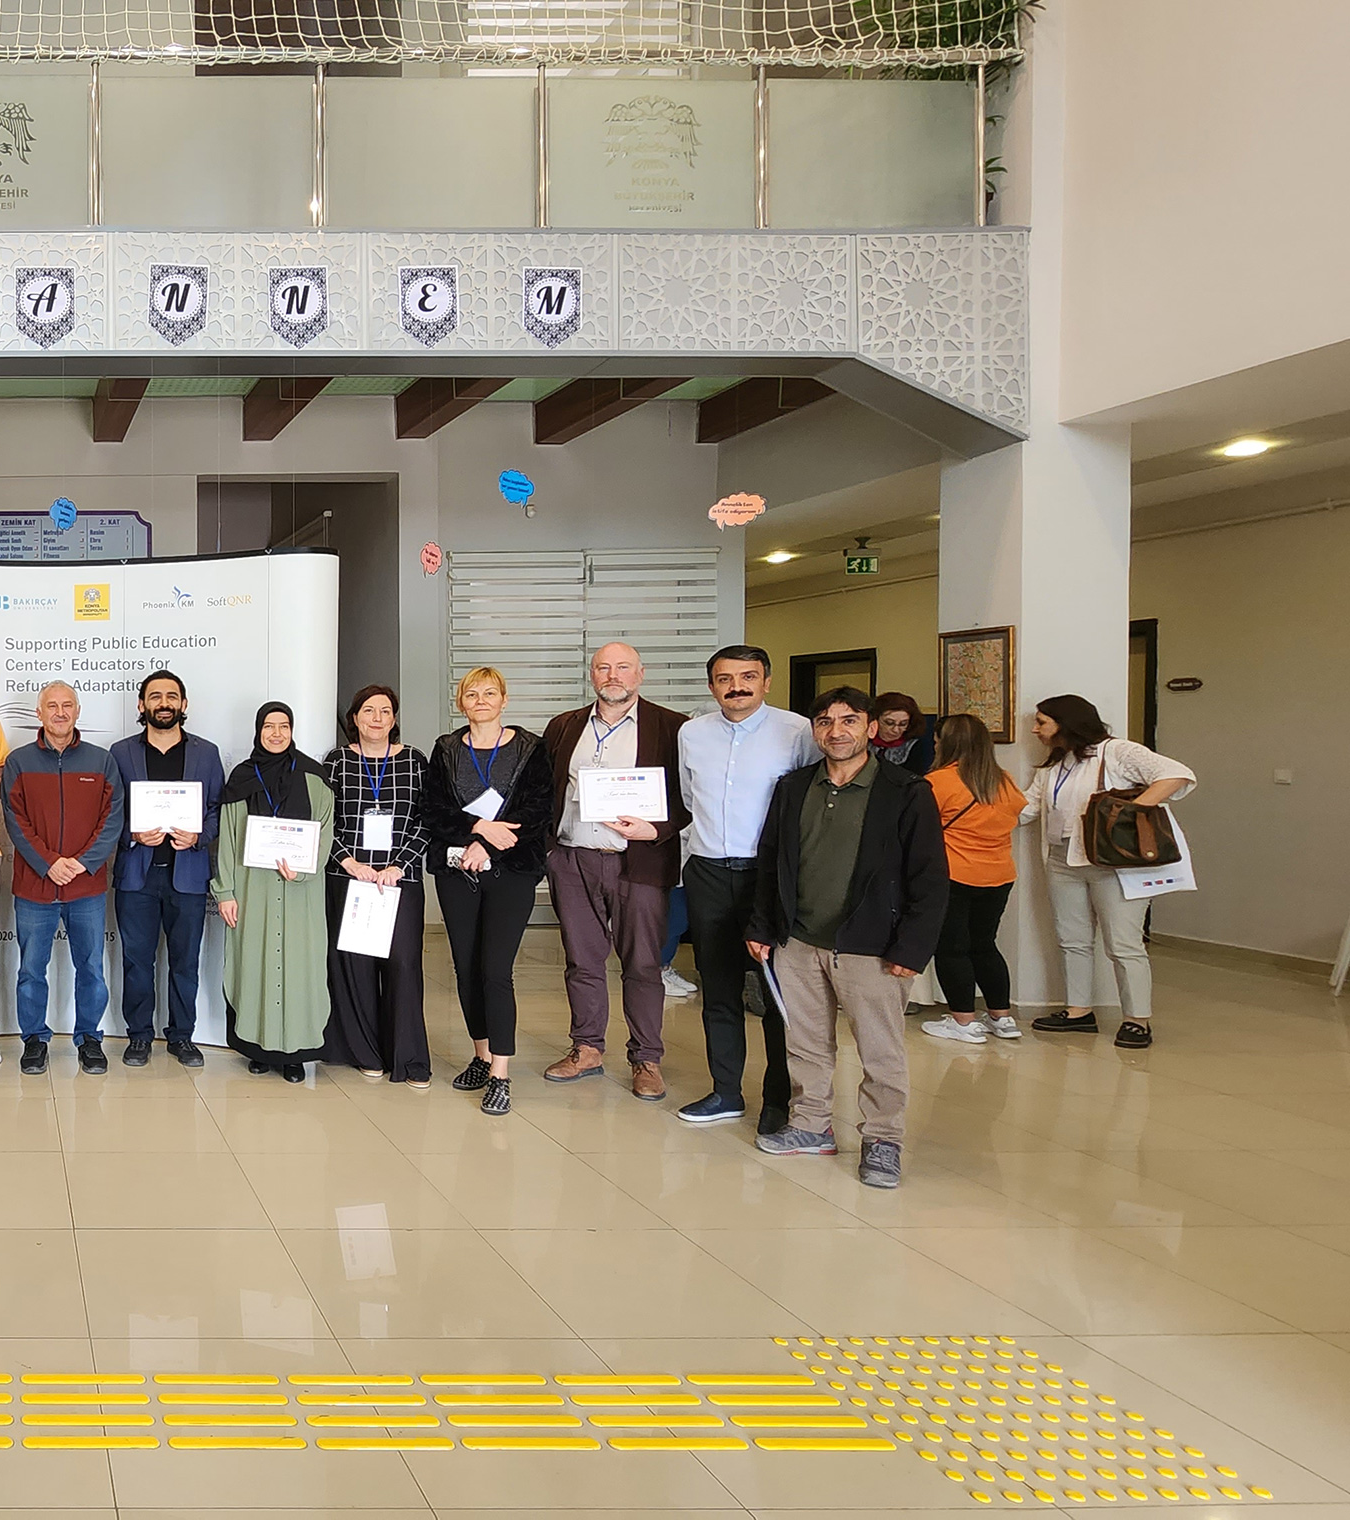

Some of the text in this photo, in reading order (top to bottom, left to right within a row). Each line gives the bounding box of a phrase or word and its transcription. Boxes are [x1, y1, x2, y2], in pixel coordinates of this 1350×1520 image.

[1, 518, 22, 526] ZEMİN
[13, 598, 58, 606] BAKIRÇAY
[142, 601, 175, 609] Phoenix
[5, 635, 217, 653] Supporting Public Education
[71, 658, 145, 671] Educators
[149, 657, 171, 670] for
[6, 679, 143, 694] Refug Adaptatio
[53, 930, 68, 940] A2
